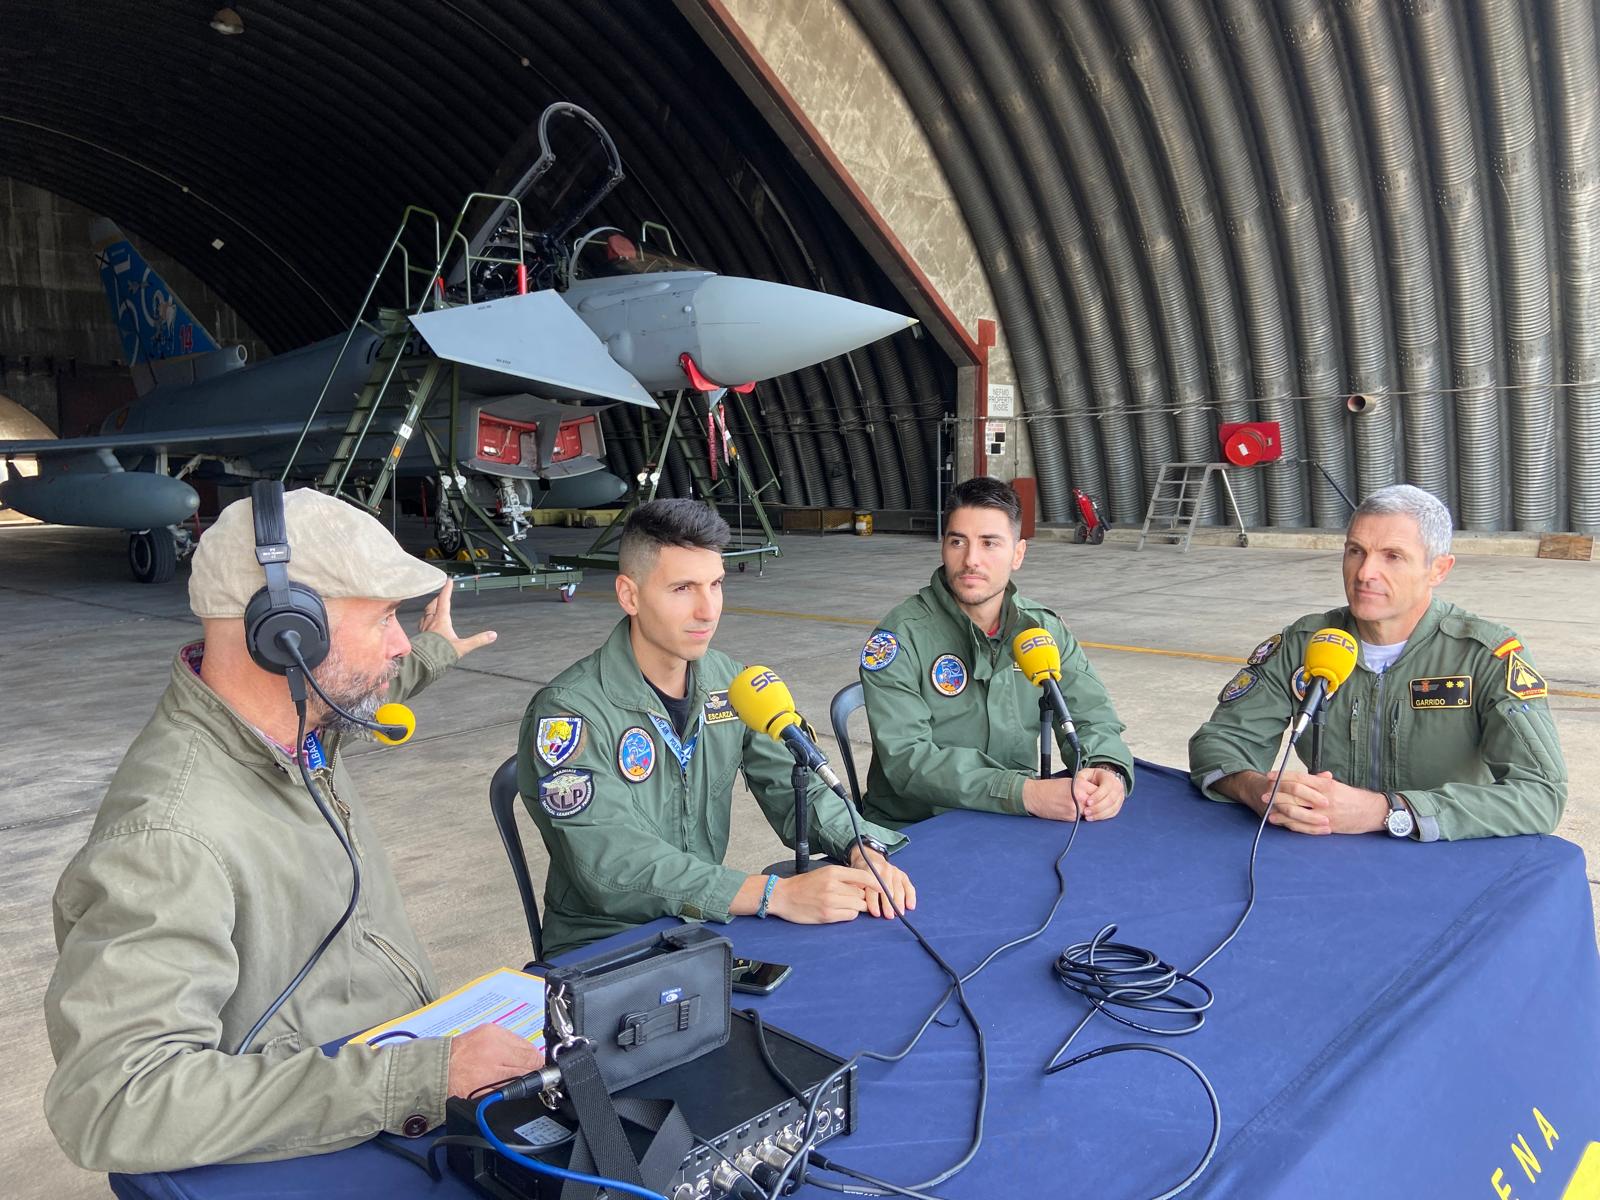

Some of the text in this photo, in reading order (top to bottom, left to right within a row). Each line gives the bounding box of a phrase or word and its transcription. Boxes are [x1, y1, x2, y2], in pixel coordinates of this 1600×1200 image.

[1312, 633, 1355, 655] SER
[1415, 698, 1468, 706] GARRIDO O+
[707, 710, 734, 721] ESCARZA
[305, 733, 323, 769] ALBACE
